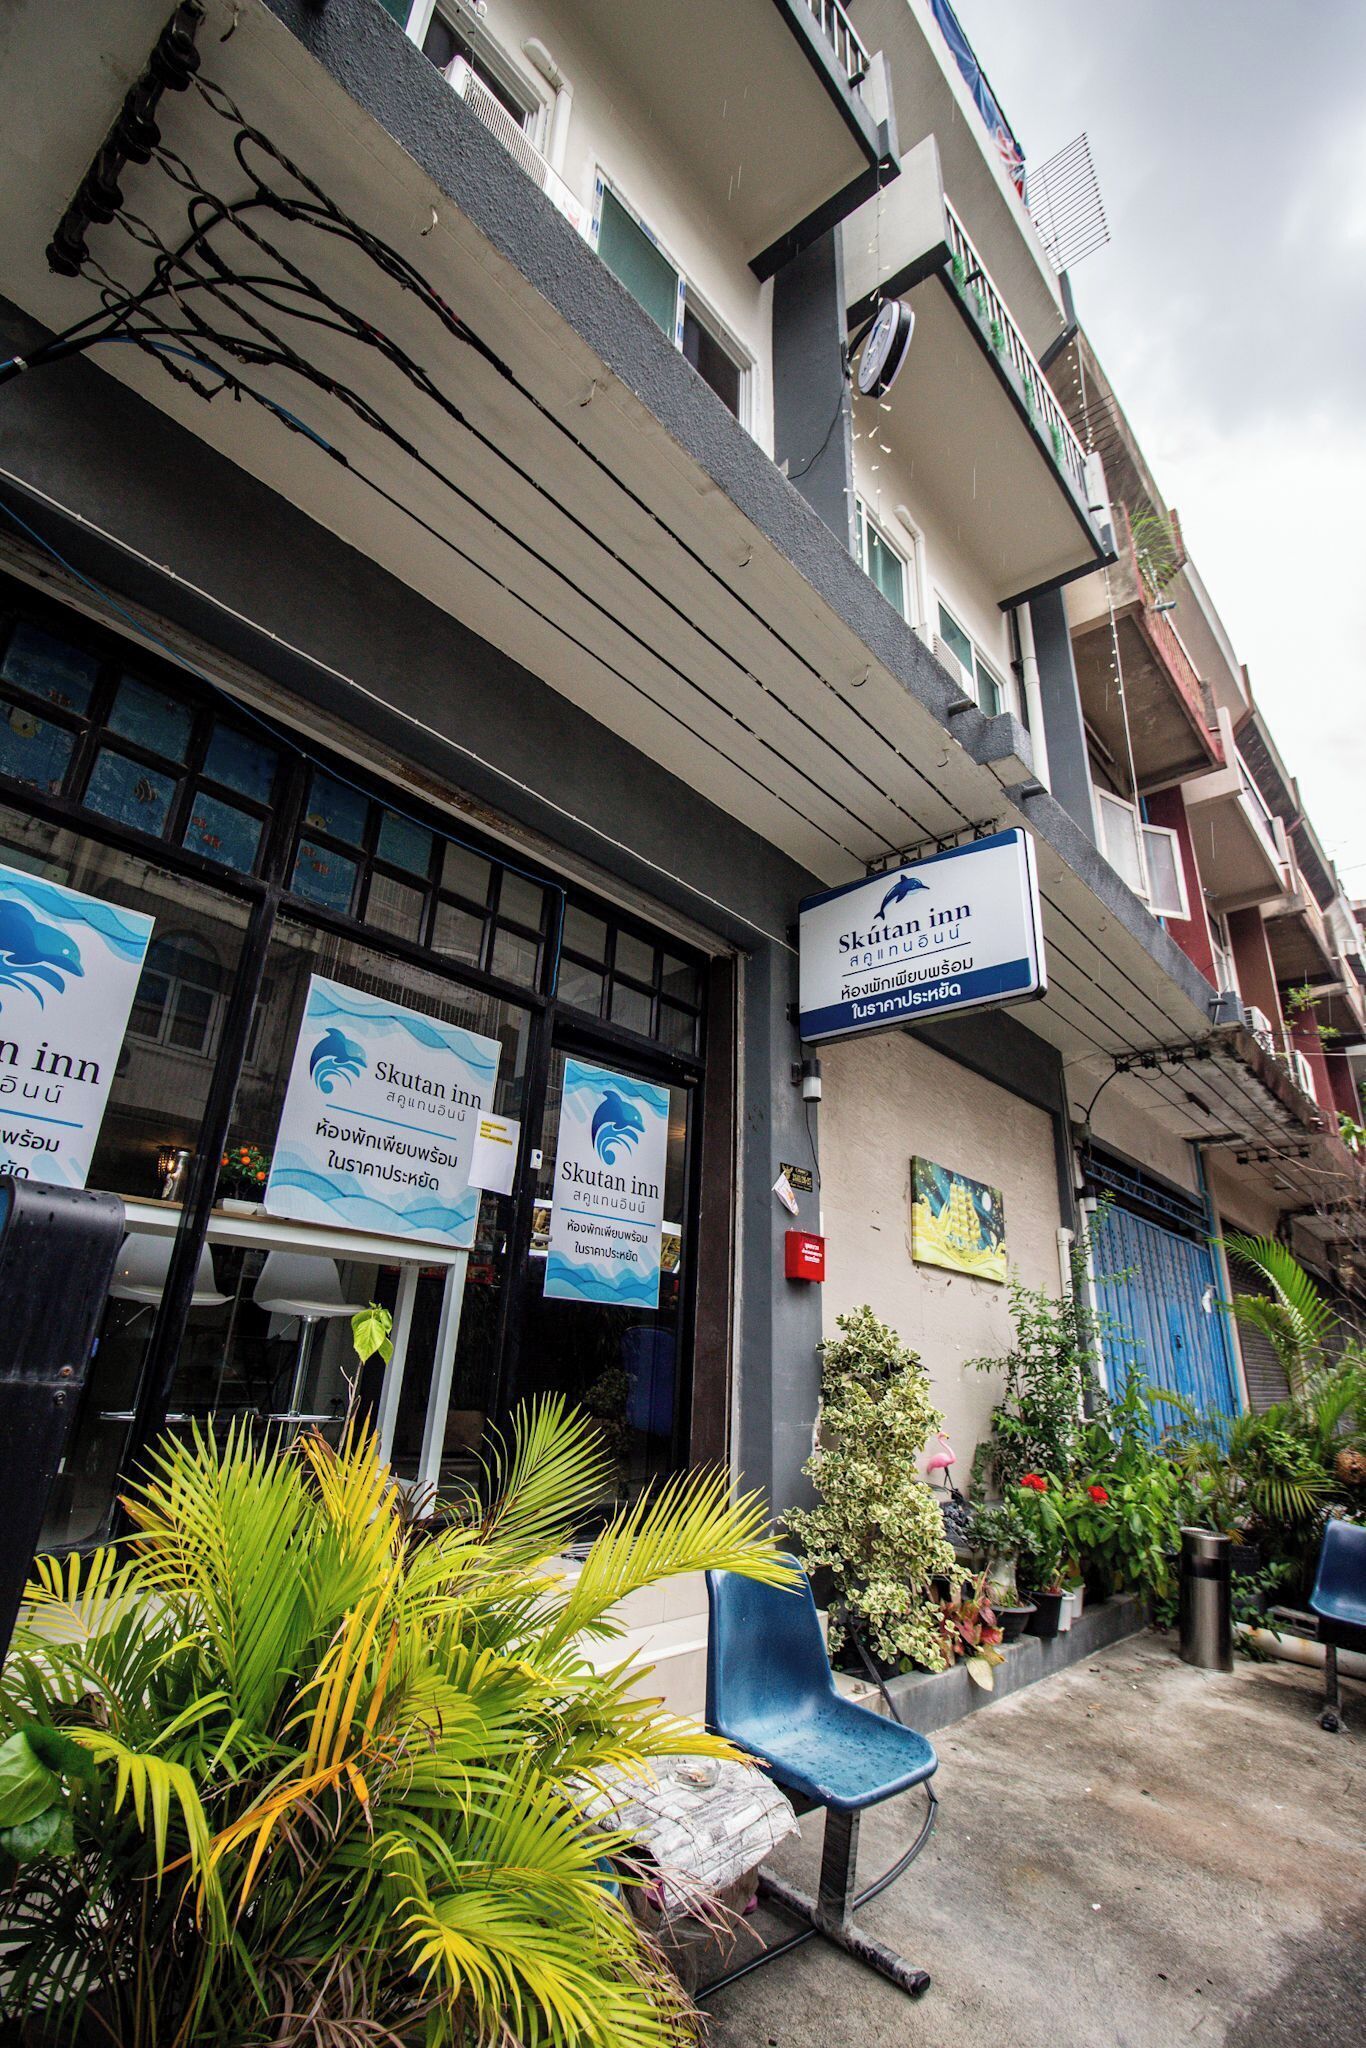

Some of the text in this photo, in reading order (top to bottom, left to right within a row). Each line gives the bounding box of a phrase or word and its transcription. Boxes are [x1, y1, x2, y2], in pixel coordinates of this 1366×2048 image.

[929, 904, 973, 928] inn
[850, 923, 960, 967] สคูแทนอินน์
[841, 957, 973, 1000] ห้องพักเพียบพร้อม
[851, 982, 962, 1019] ในราคาประหยัด
[31, 1042, 100, 1085] inn
[375, 1061, 482, 1110] Skutan inn
[386, 1091, 467, 1122] สคูแทนอินน์
[316, 1117, 458, 1168] ห้องพักเพียบพร้อม
[328, 1149, 440, 1191] ในราคาประหยัด
[561, 1161, 660, 1200] Skutan inn
[573, 1190, 646, 1213] สคูแทนอินน์
[567, 1219, 648, 1244] ห้องพักเพียบพร้อม
[575, 1241, 638, 1262] ในราคาประหยัด
